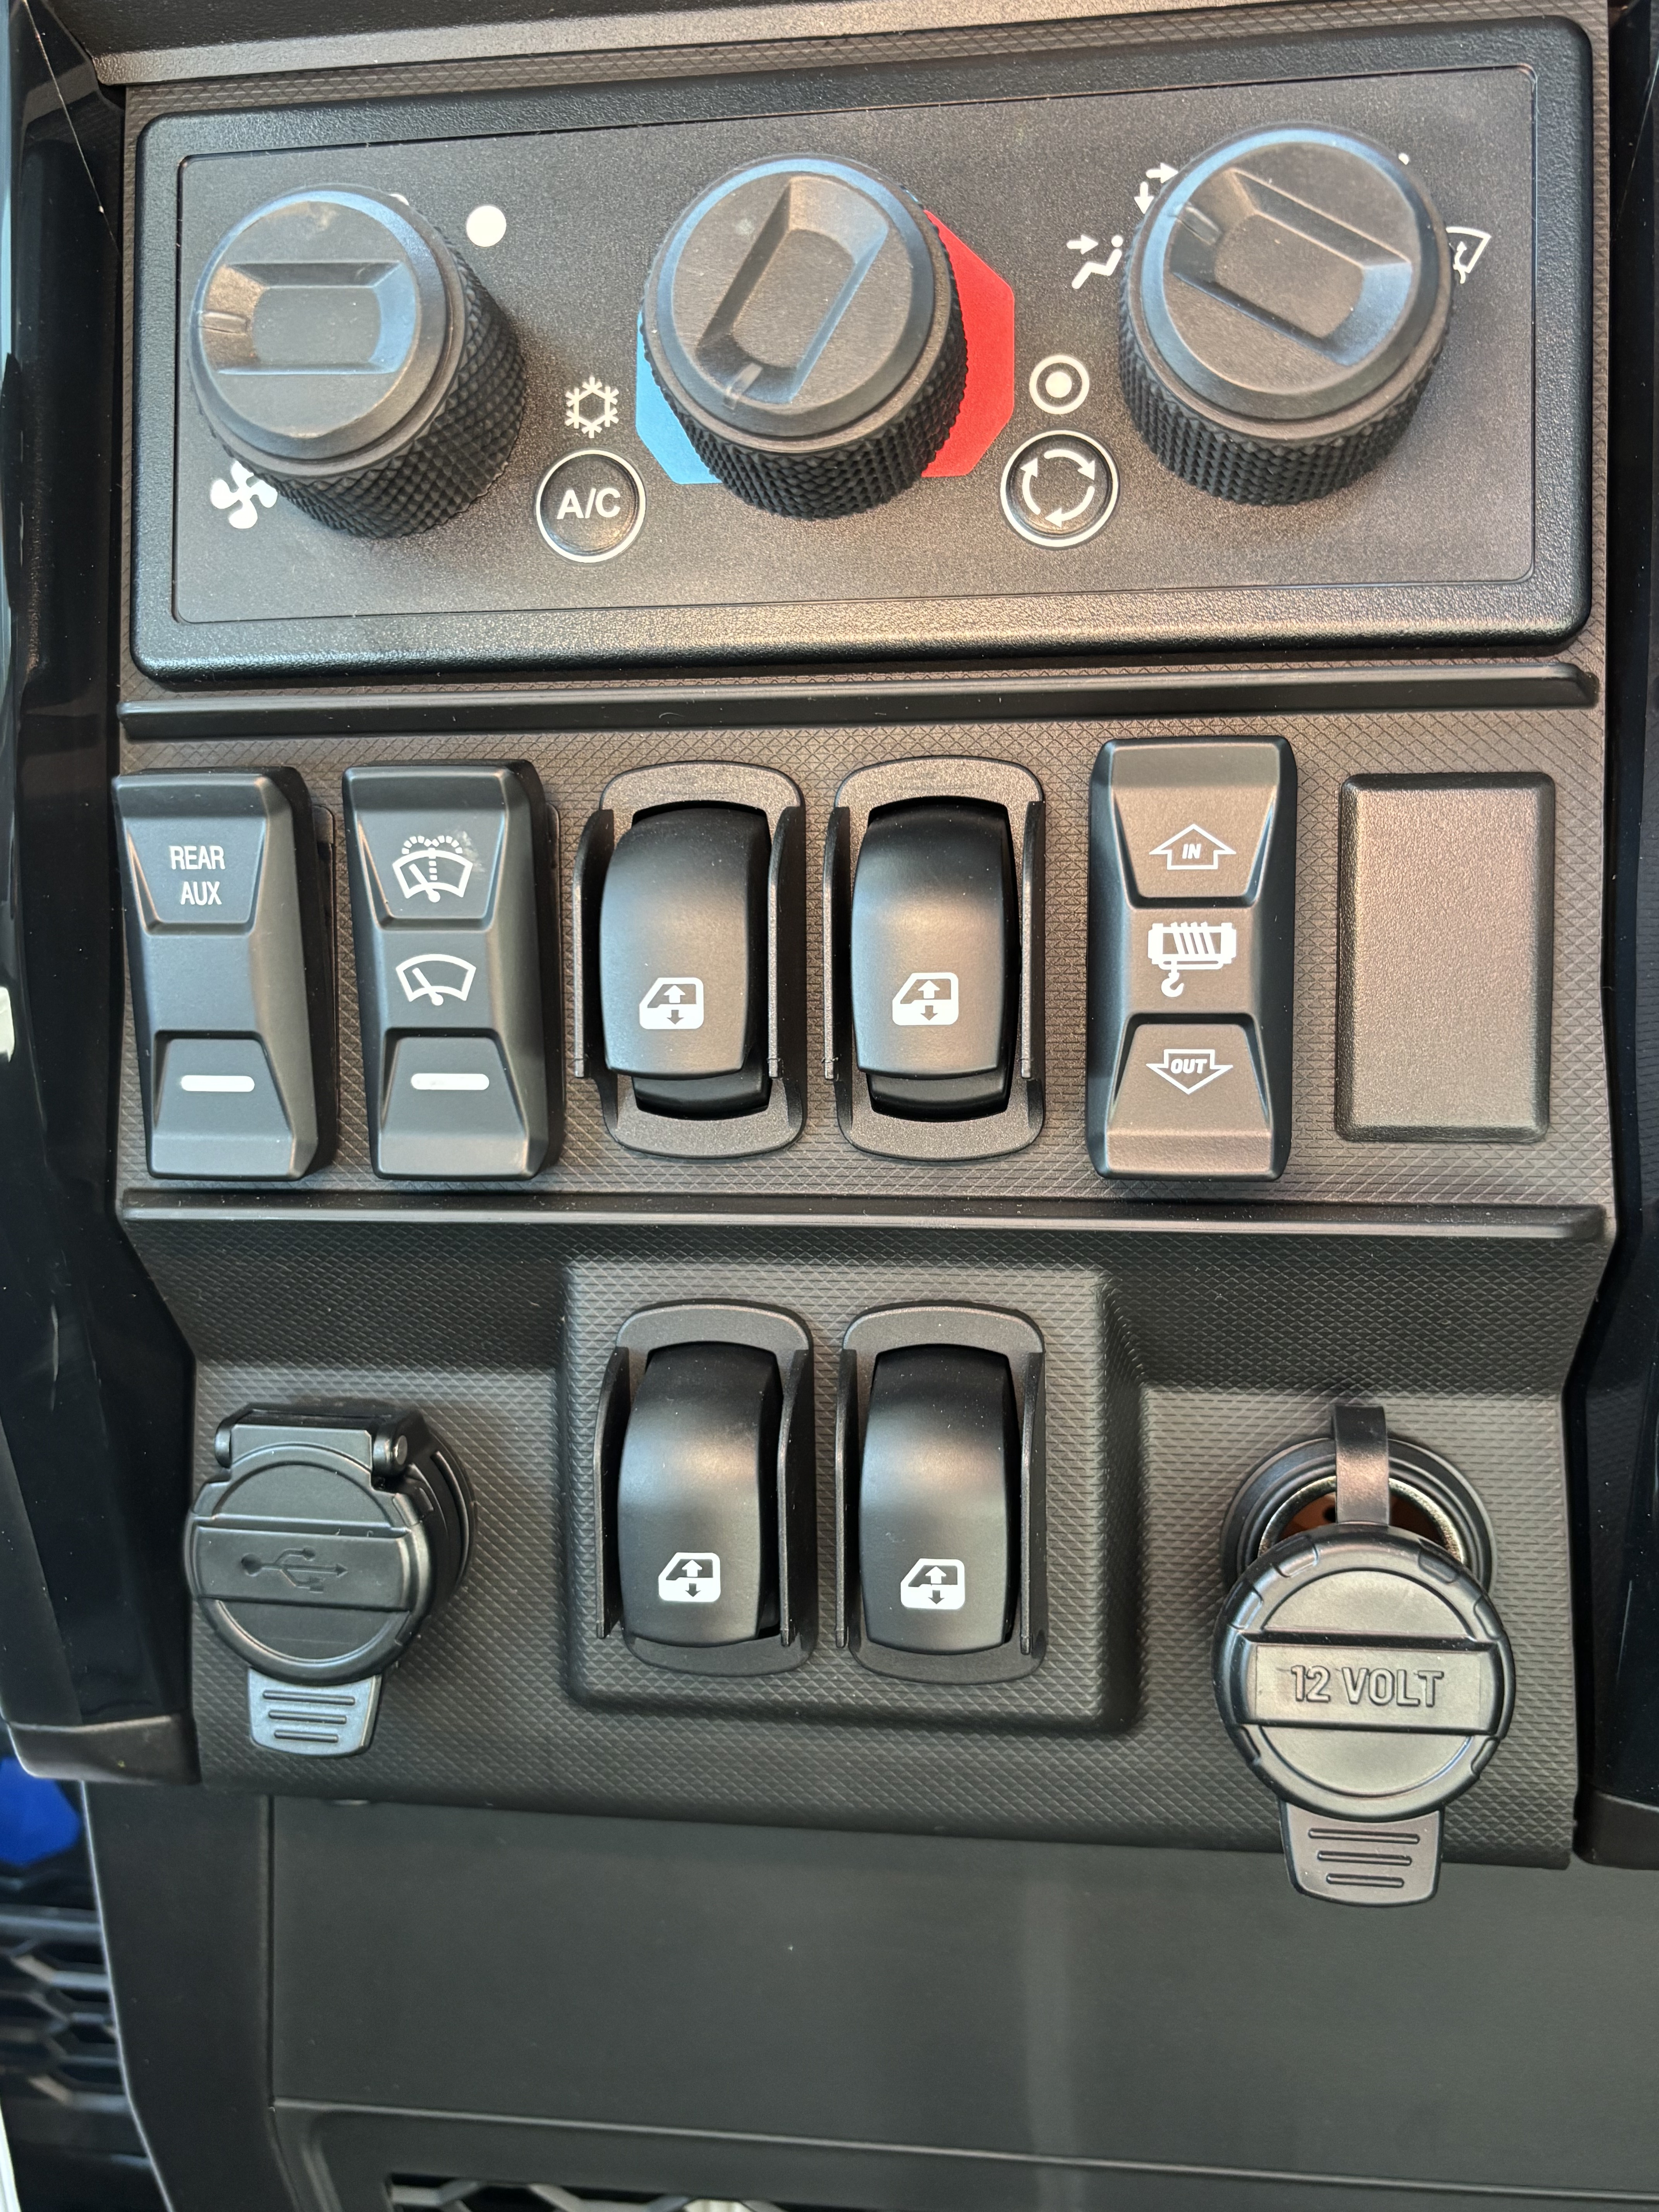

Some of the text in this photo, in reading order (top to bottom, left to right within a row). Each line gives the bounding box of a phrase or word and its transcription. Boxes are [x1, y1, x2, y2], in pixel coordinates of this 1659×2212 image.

[556, 488, 621, 520] A/C
[169, 845, 225, 870] REAR
[1182, 843, 1202, 859] IN
[180, 881, 222, 905] AUX
[1170, 1058, 1207, 1074] OUT
[1291, 1665, 1444, 1707] 12 VOLT
